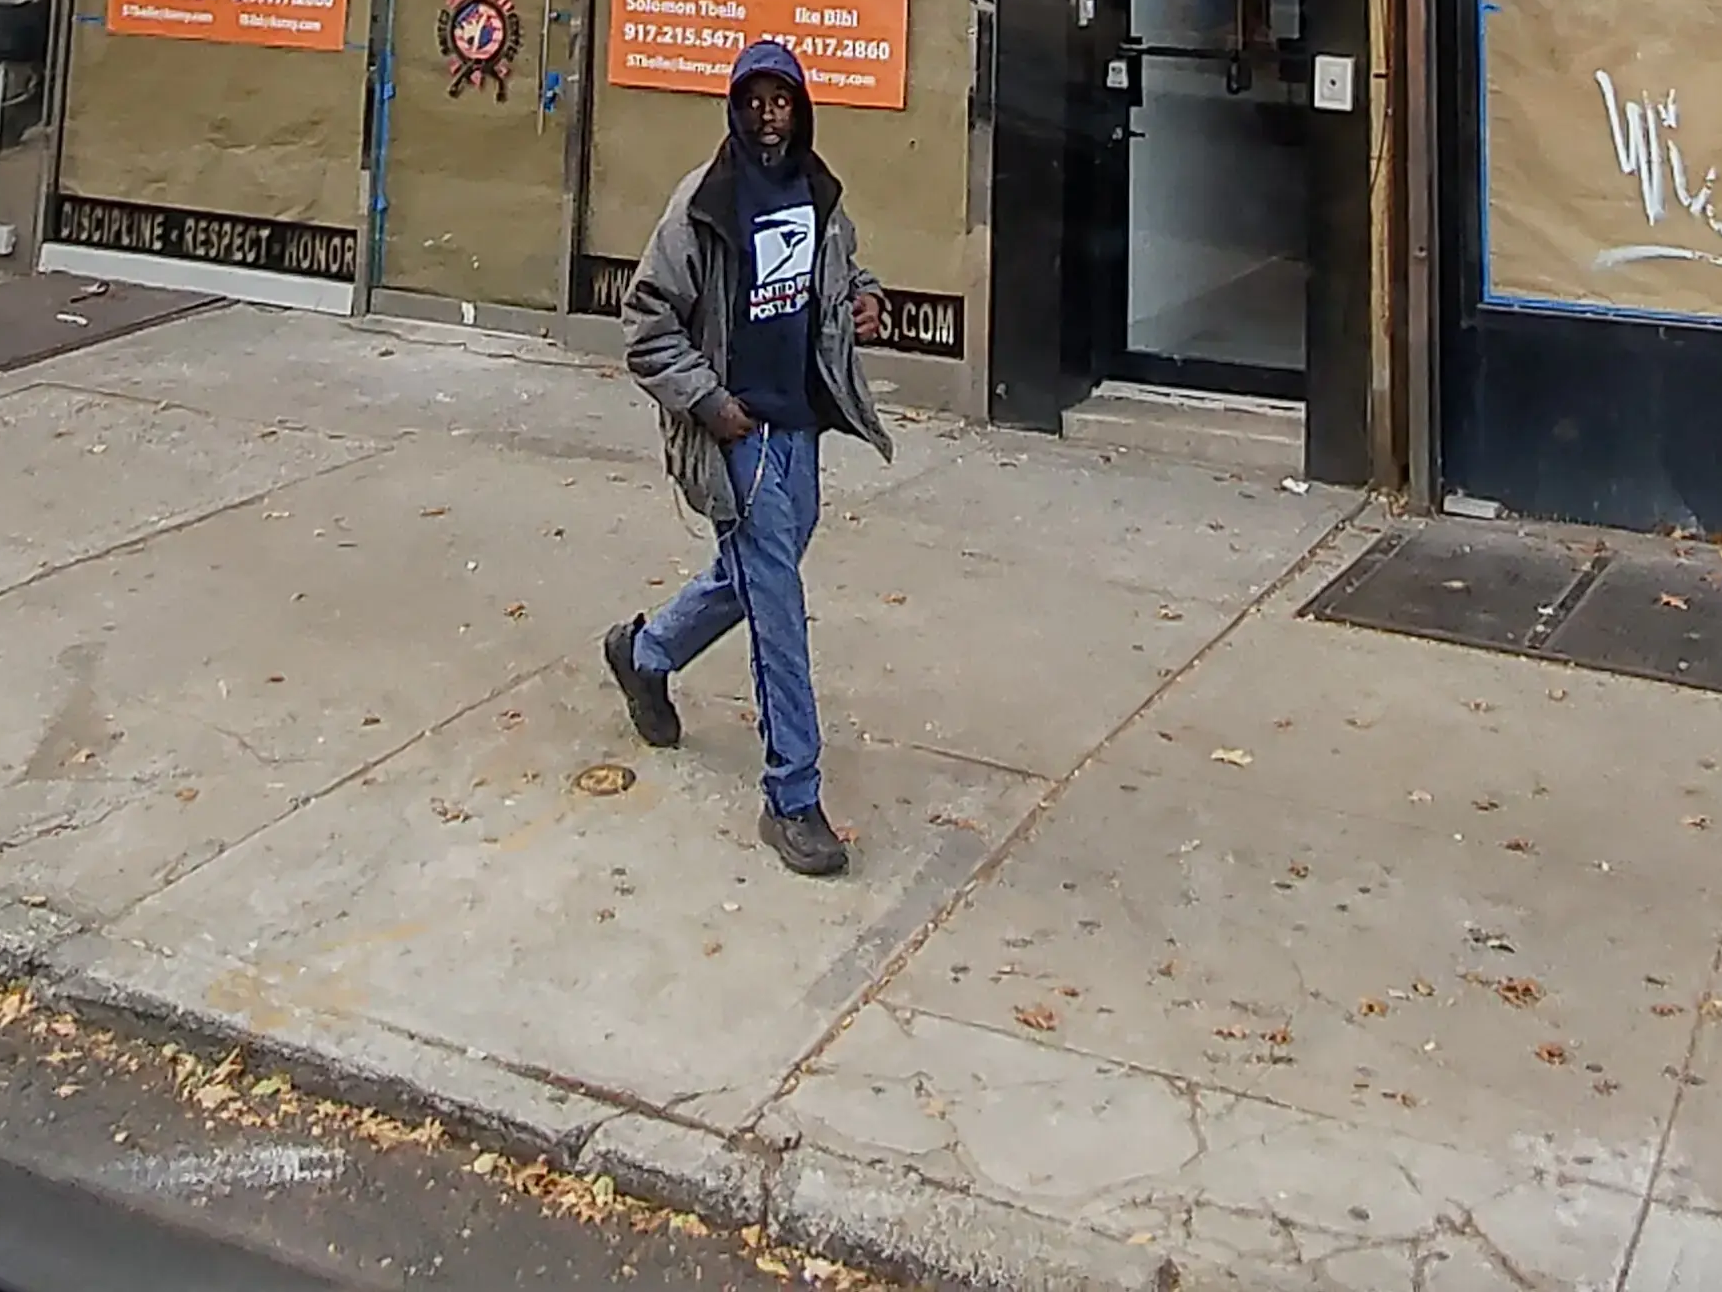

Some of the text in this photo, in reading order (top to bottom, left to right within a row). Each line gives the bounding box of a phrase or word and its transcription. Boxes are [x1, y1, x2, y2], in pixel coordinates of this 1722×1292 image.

[623, 22, 746, 50] 917.215.5471
[59, 200, 356, 274] DISCIPLINE RESPECT HONOR
